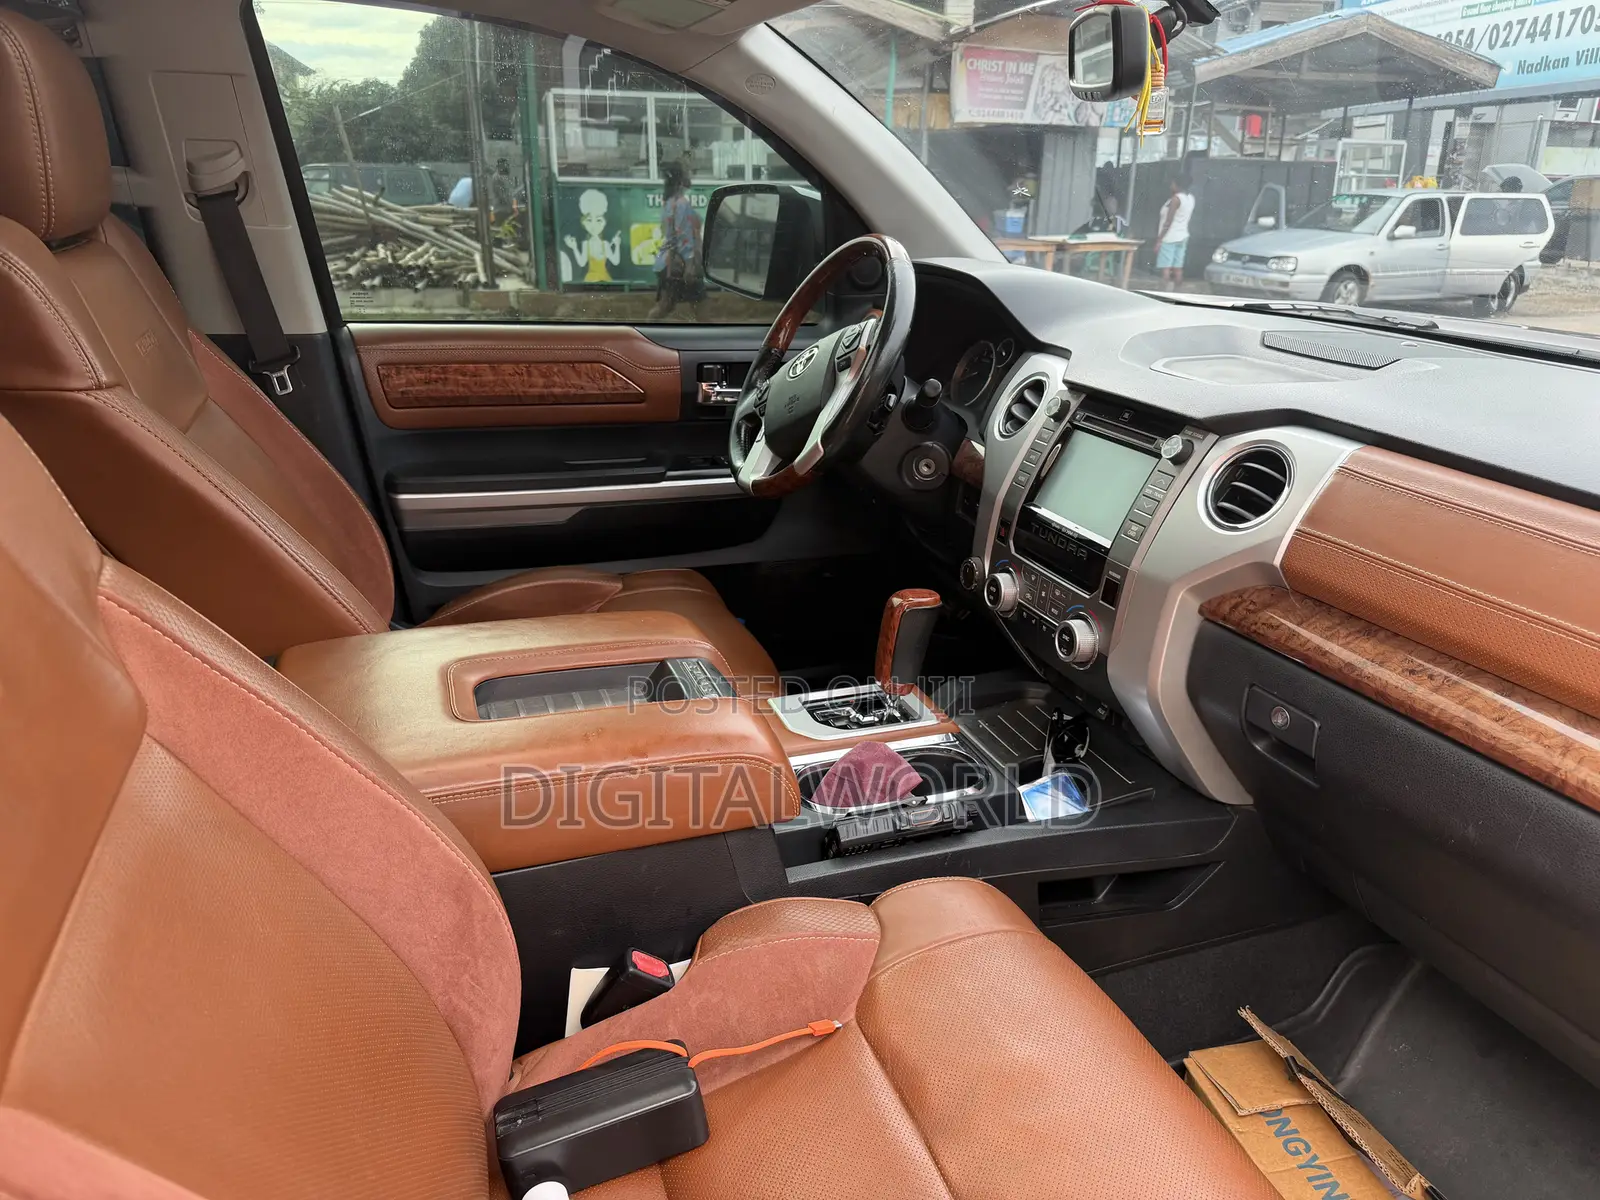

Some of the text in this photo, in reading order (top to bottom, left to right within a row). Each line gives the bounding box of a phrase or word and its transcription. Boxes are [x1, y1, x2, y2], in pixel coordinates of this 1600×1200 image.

[966, 58, 1034, 75] CHRIST IN ME
[1517, 46, 1600, 75] Nadkan Vill
[1030, 522, 1088, 560] TUNDRA
